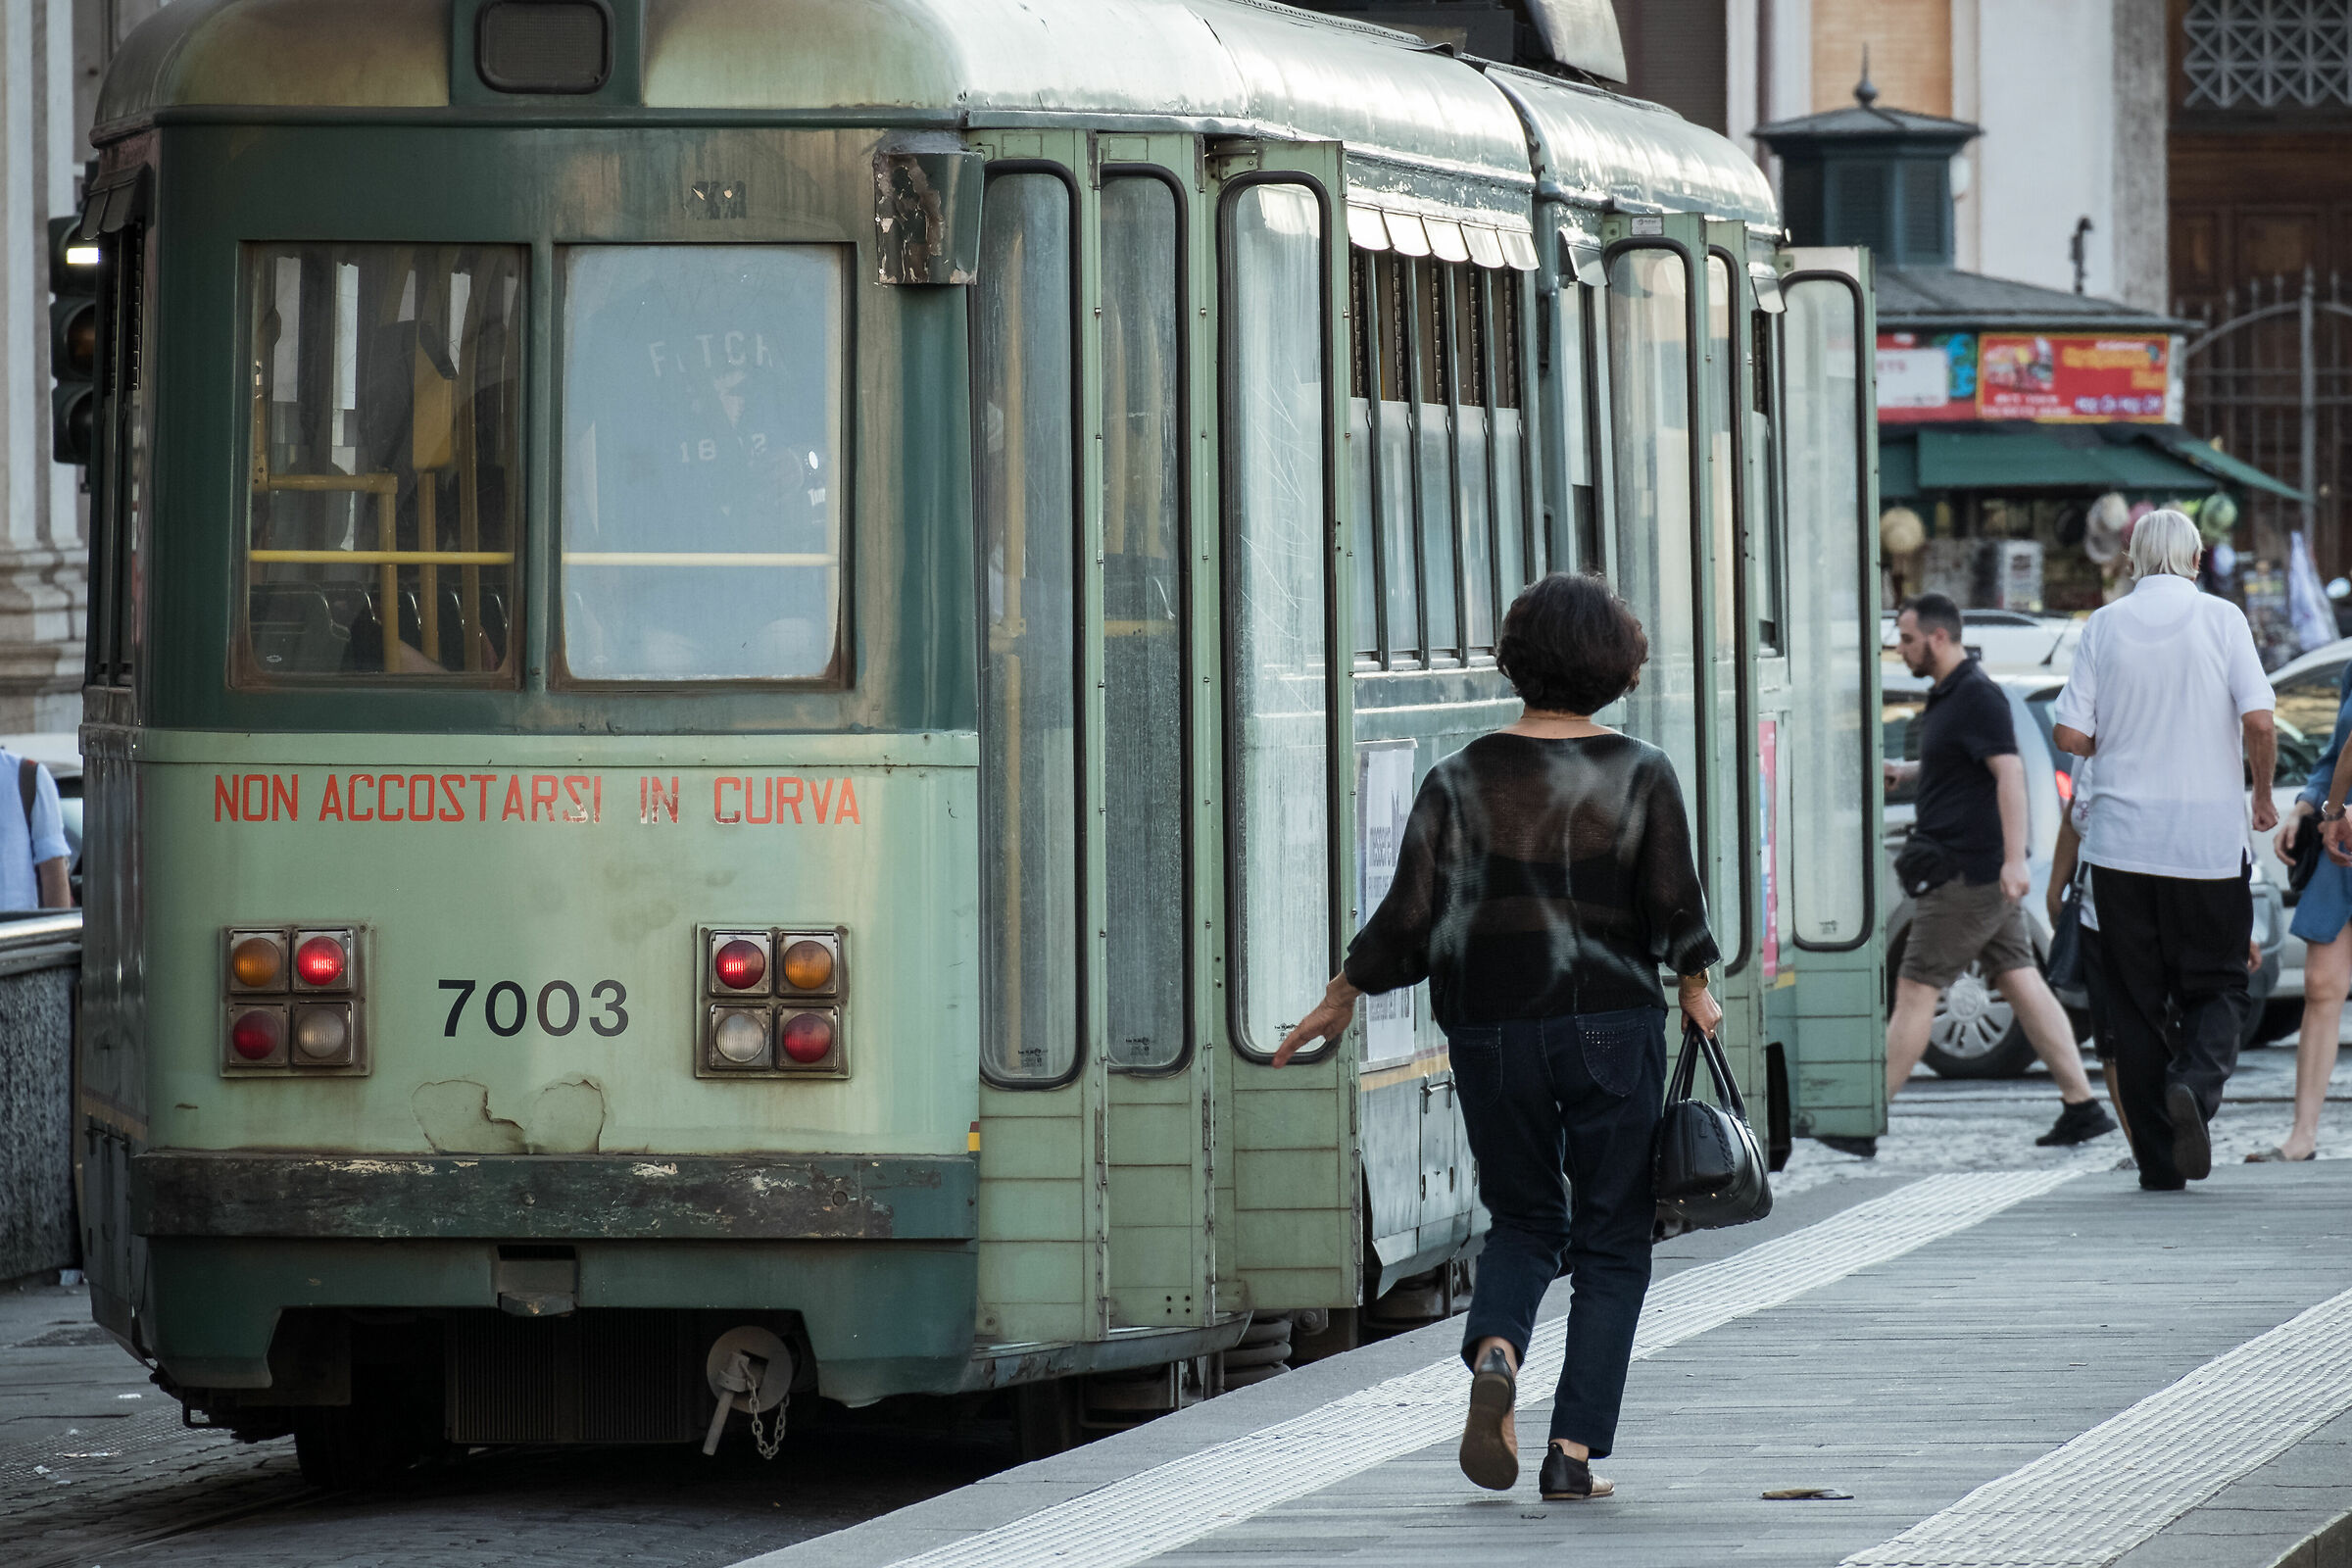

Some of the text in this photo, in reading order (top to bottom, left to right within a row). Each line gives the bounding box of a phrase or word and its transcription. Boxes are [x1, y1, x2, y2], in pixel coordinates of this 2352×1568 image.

[213, 773, 862, 826] NON ACCOSTARSI IN CURVA
[437, 979, 630, 1038] 7003
